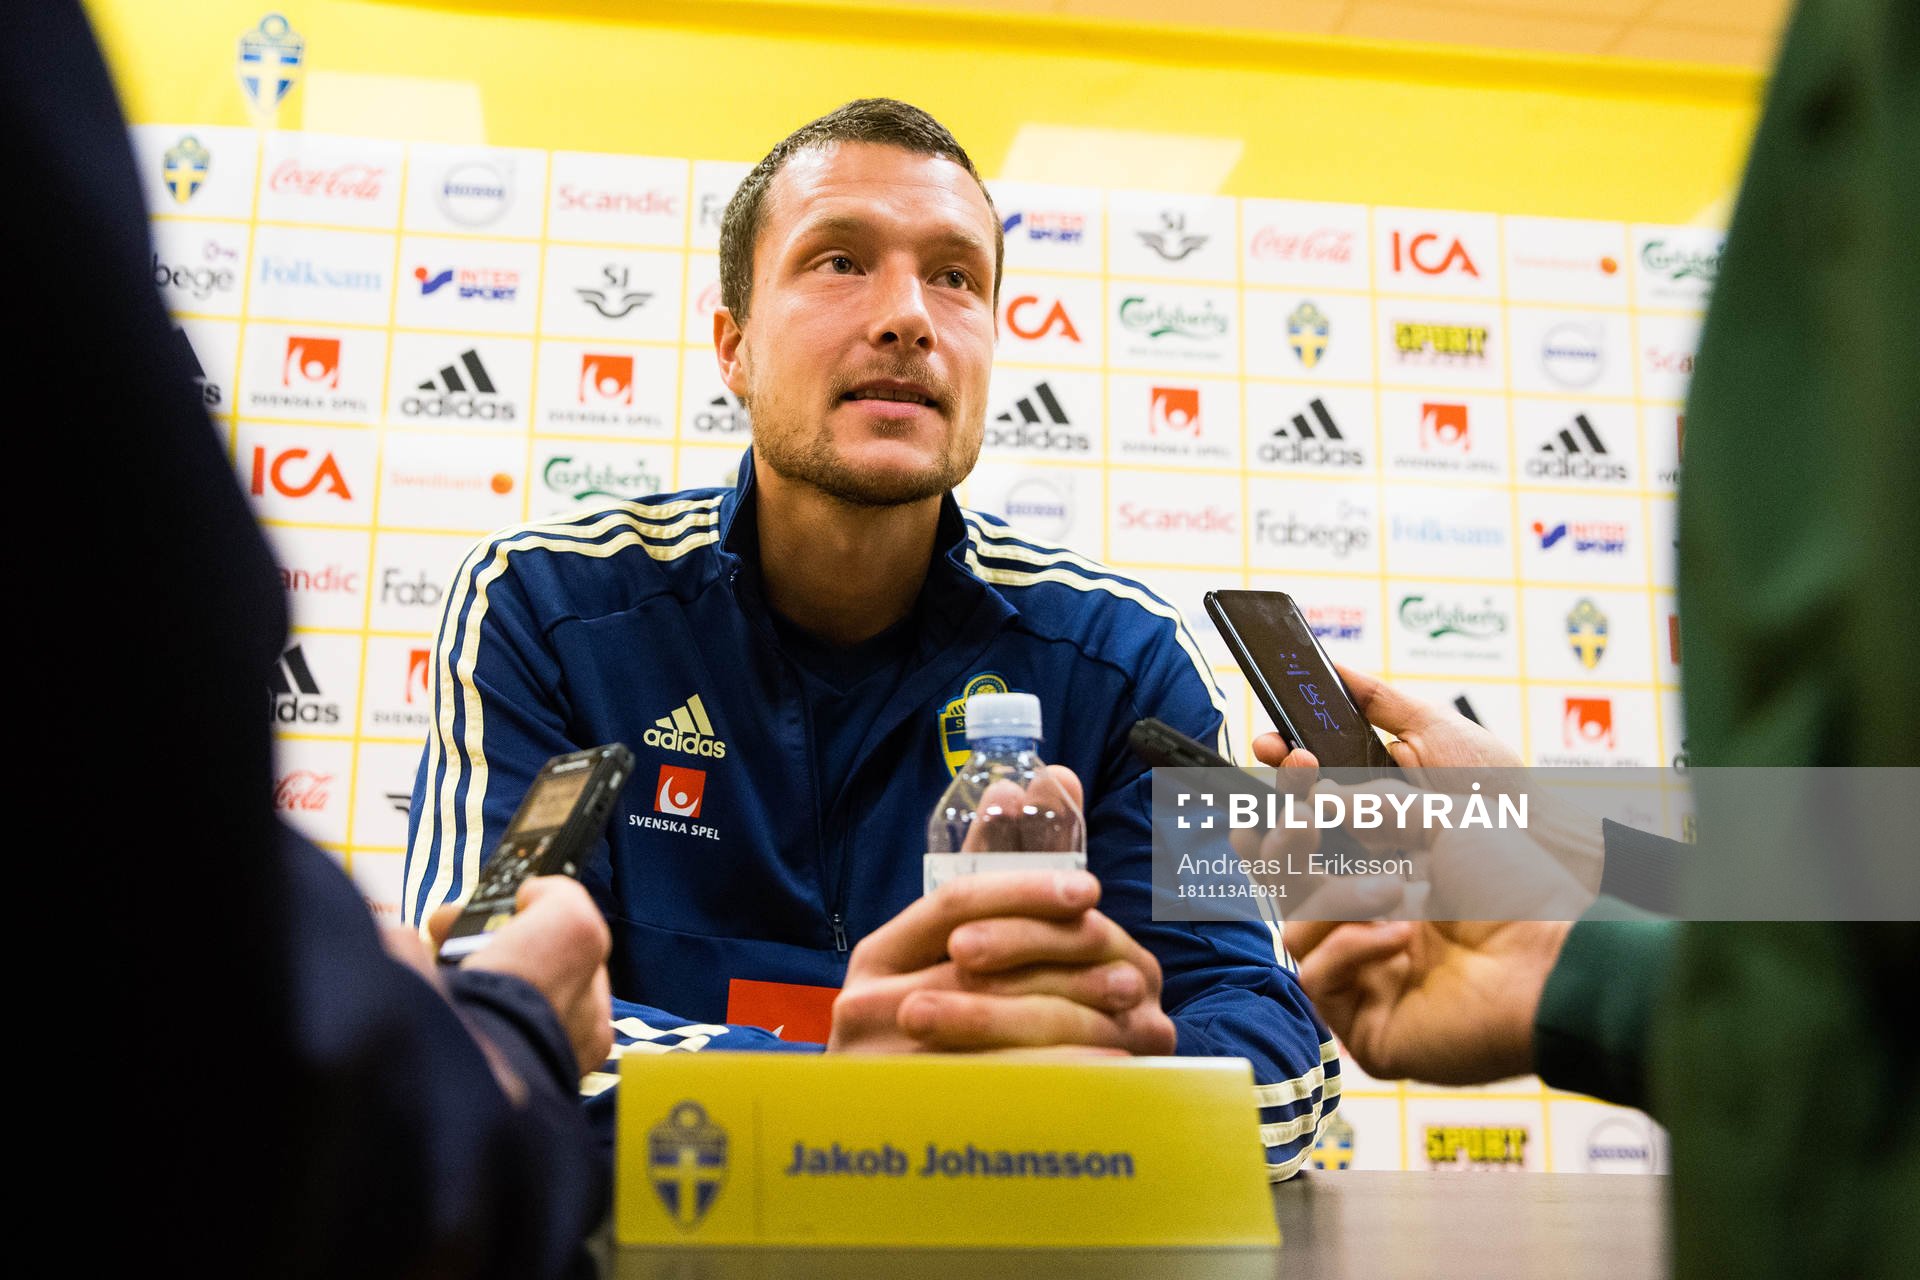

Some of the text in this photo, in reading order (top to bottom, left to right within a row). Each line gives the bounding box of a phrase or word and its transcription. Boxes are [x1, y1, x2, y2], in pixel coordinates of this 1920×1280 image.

[558, 185, 679, 215] Scandic
[1393, 231, 1479, 277] ICA
[153, 252, 234, 300] bege
[1006, 295, 1082, 343] CA
[401, 391, 516, 421] adidas
[985, 422, 1091, 451] adidas
[1258, 439, 1364, 466] adidas
[1526, 452, 1628, 480] adidas
[252, 446, 353, 501] ICA
[544, 457, 662, 496] Carlsberg
[1119, 503, 1237, 533] Scandic
[1256, 509, 1370, 558] Fabege
[280, 565, 358, 593] andic
[643, 728, 727, 758] adidas
[628, 814, 721, 840] SVENSKA SPEL
[787, 1142, 1136, 1179] Jakob Johansson
